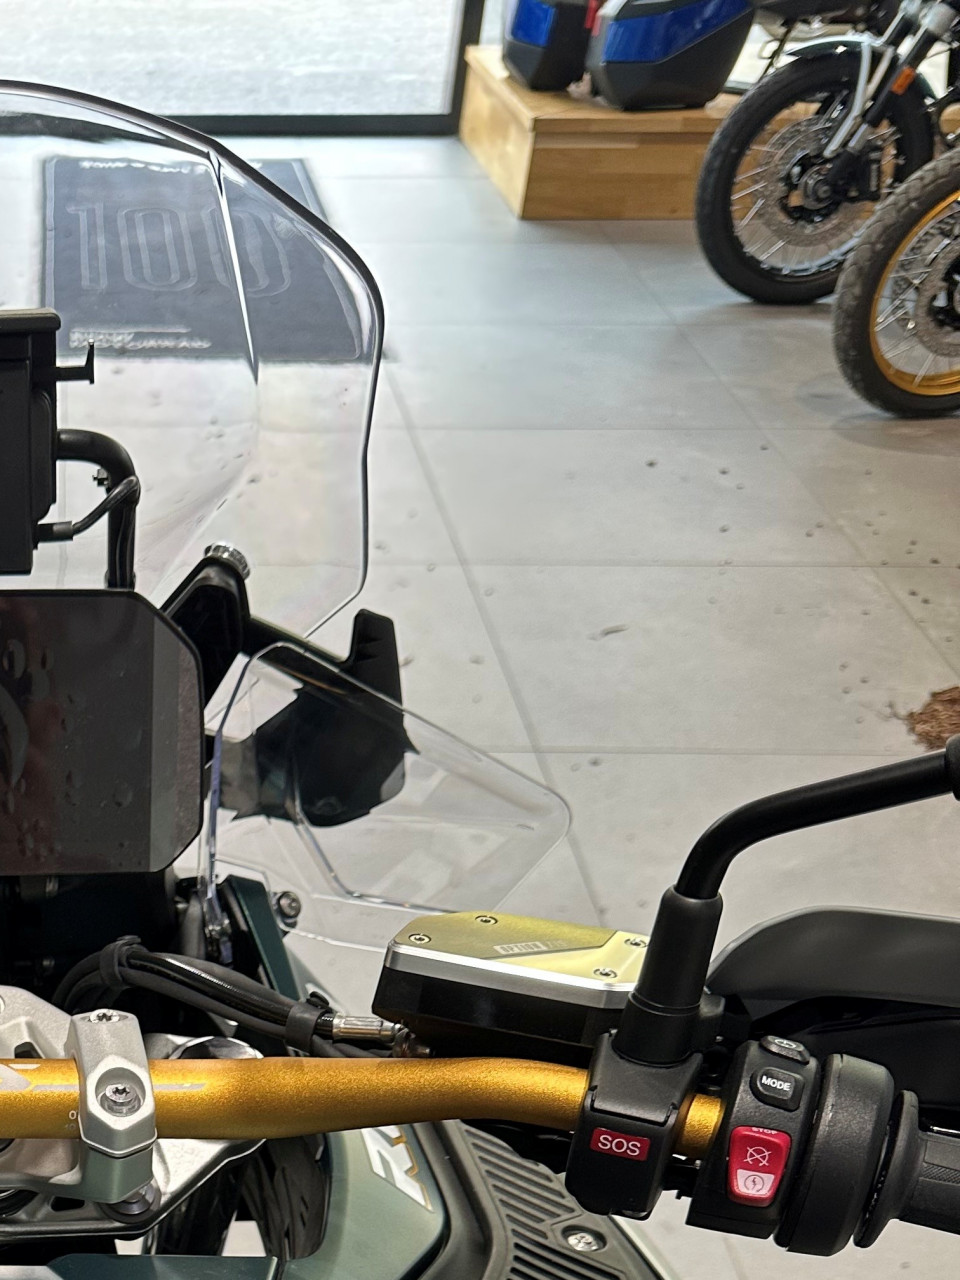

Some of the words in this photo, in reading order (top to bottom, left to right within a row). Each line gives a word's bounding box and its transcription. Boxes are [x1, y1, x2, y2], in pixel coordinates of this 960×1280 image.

[499, 942, 542, 953] OPTION
[761, 1075, 791, 1091] MODE
[751, 1126, 778, 1135] STOP
[597, 1134, 642, 1156] SOS
